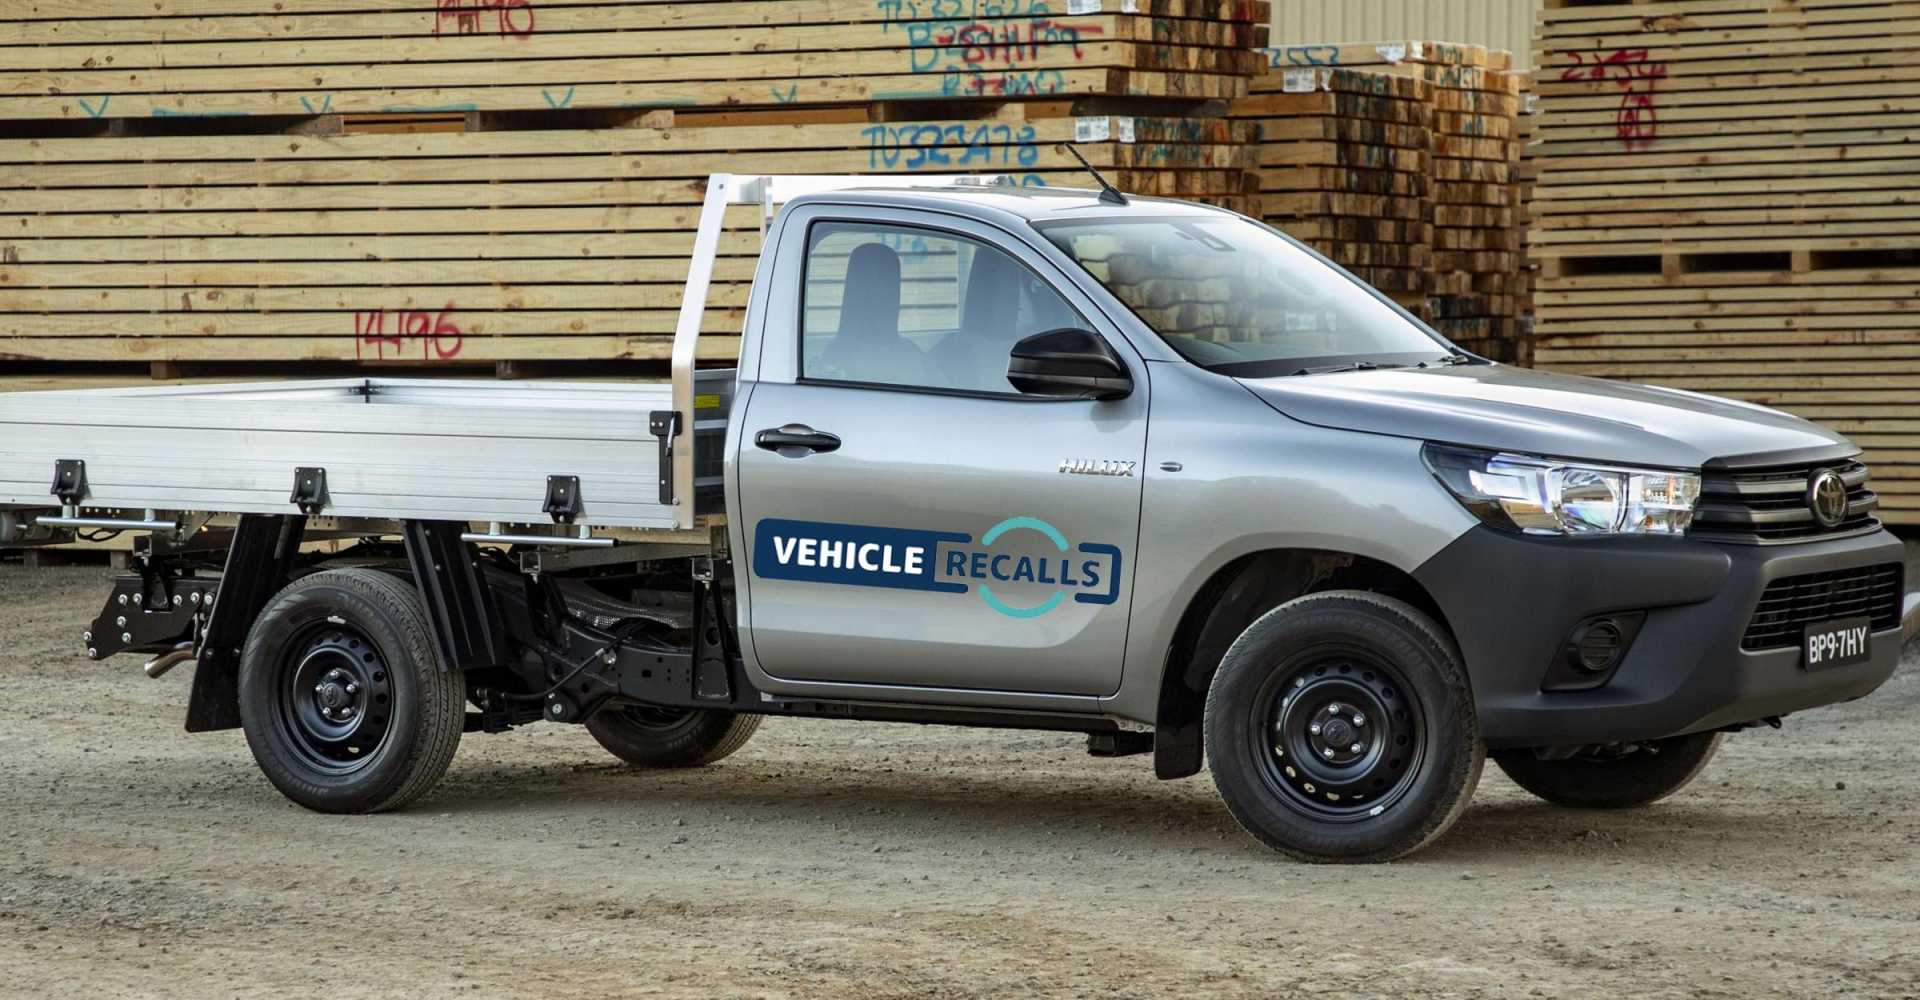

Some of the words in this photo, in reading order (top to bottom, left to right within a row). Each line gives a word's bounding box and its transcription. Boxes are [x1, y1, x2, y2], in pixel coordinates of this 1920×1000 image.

[1059, 459, 1137, 477] HILUX
[773, 536, 924, 575] VEHICLE
[946, 550, 1101, 587] RECALLS
